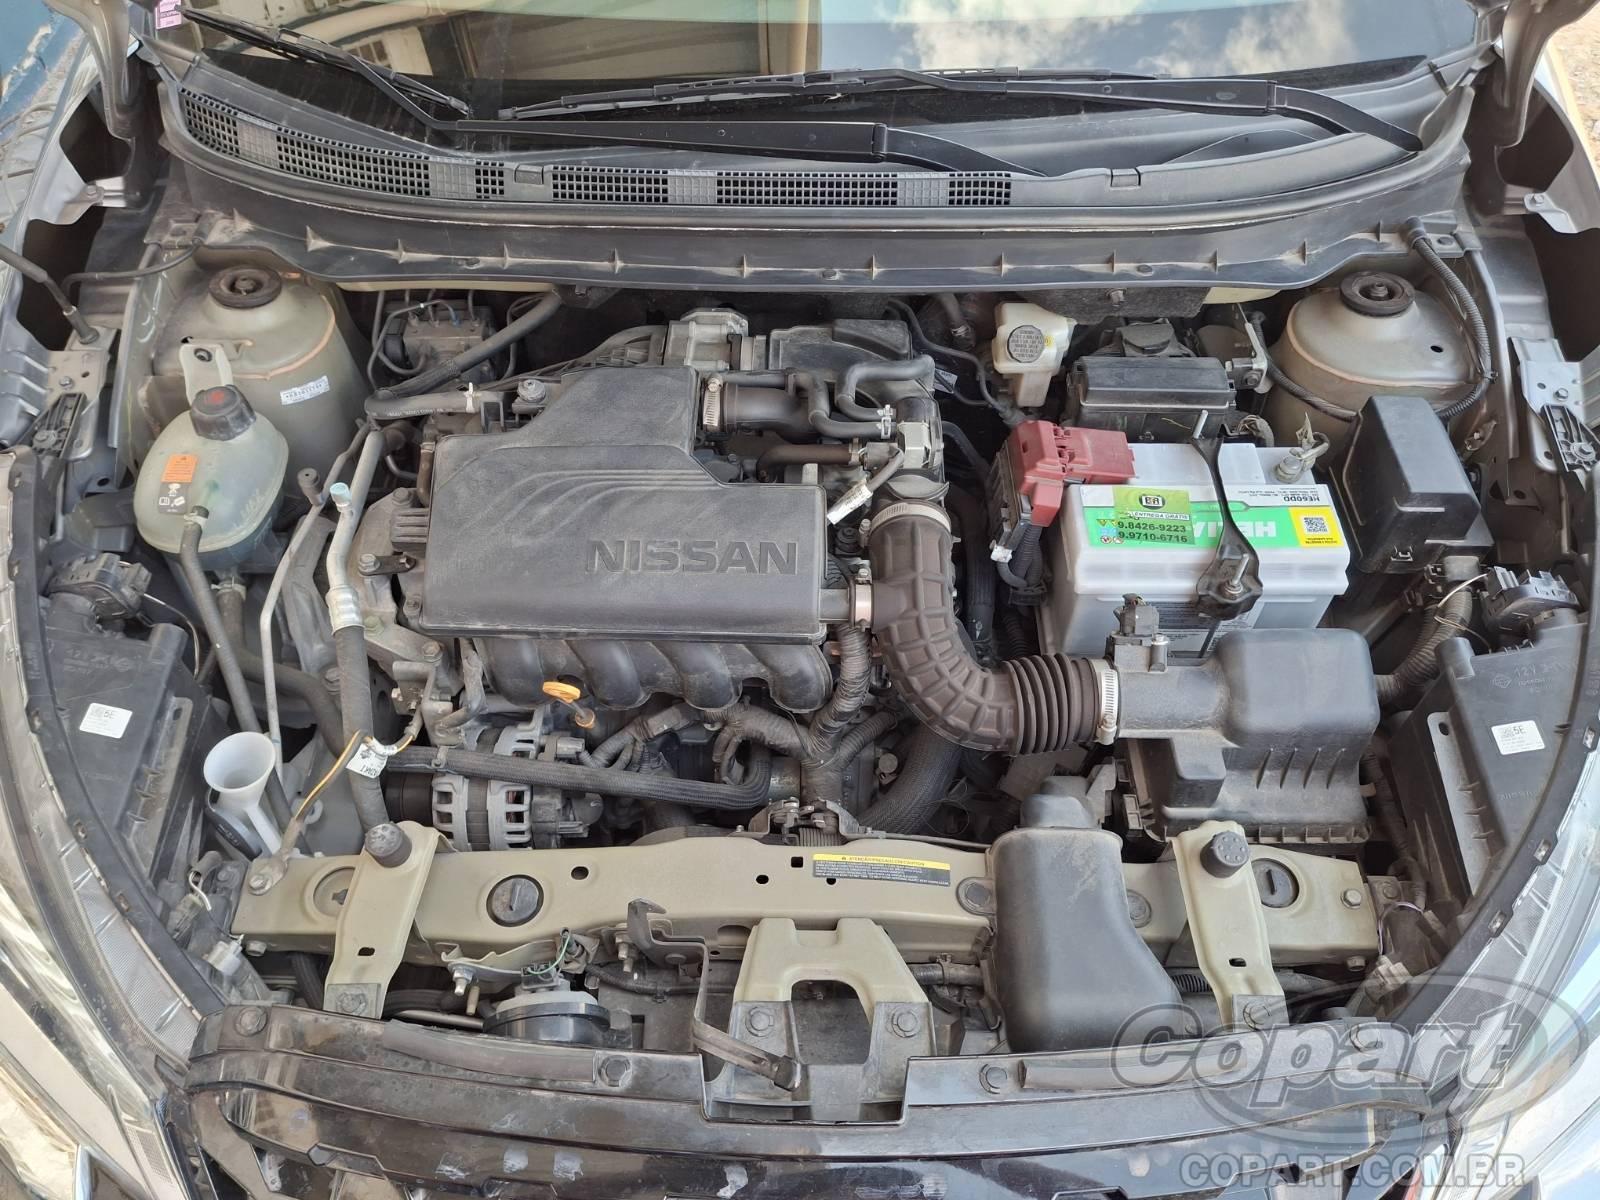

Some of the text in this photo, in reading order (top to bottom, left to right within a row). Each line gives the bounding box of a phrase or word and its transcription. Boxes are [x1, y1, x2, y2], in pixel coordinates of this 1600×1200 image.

[1118, 521, 1186, 533] 9.8426-9223
[1118, 531, 1188, 543] 9.9710-6716
[585, 540, 798, 575] NISSAN
